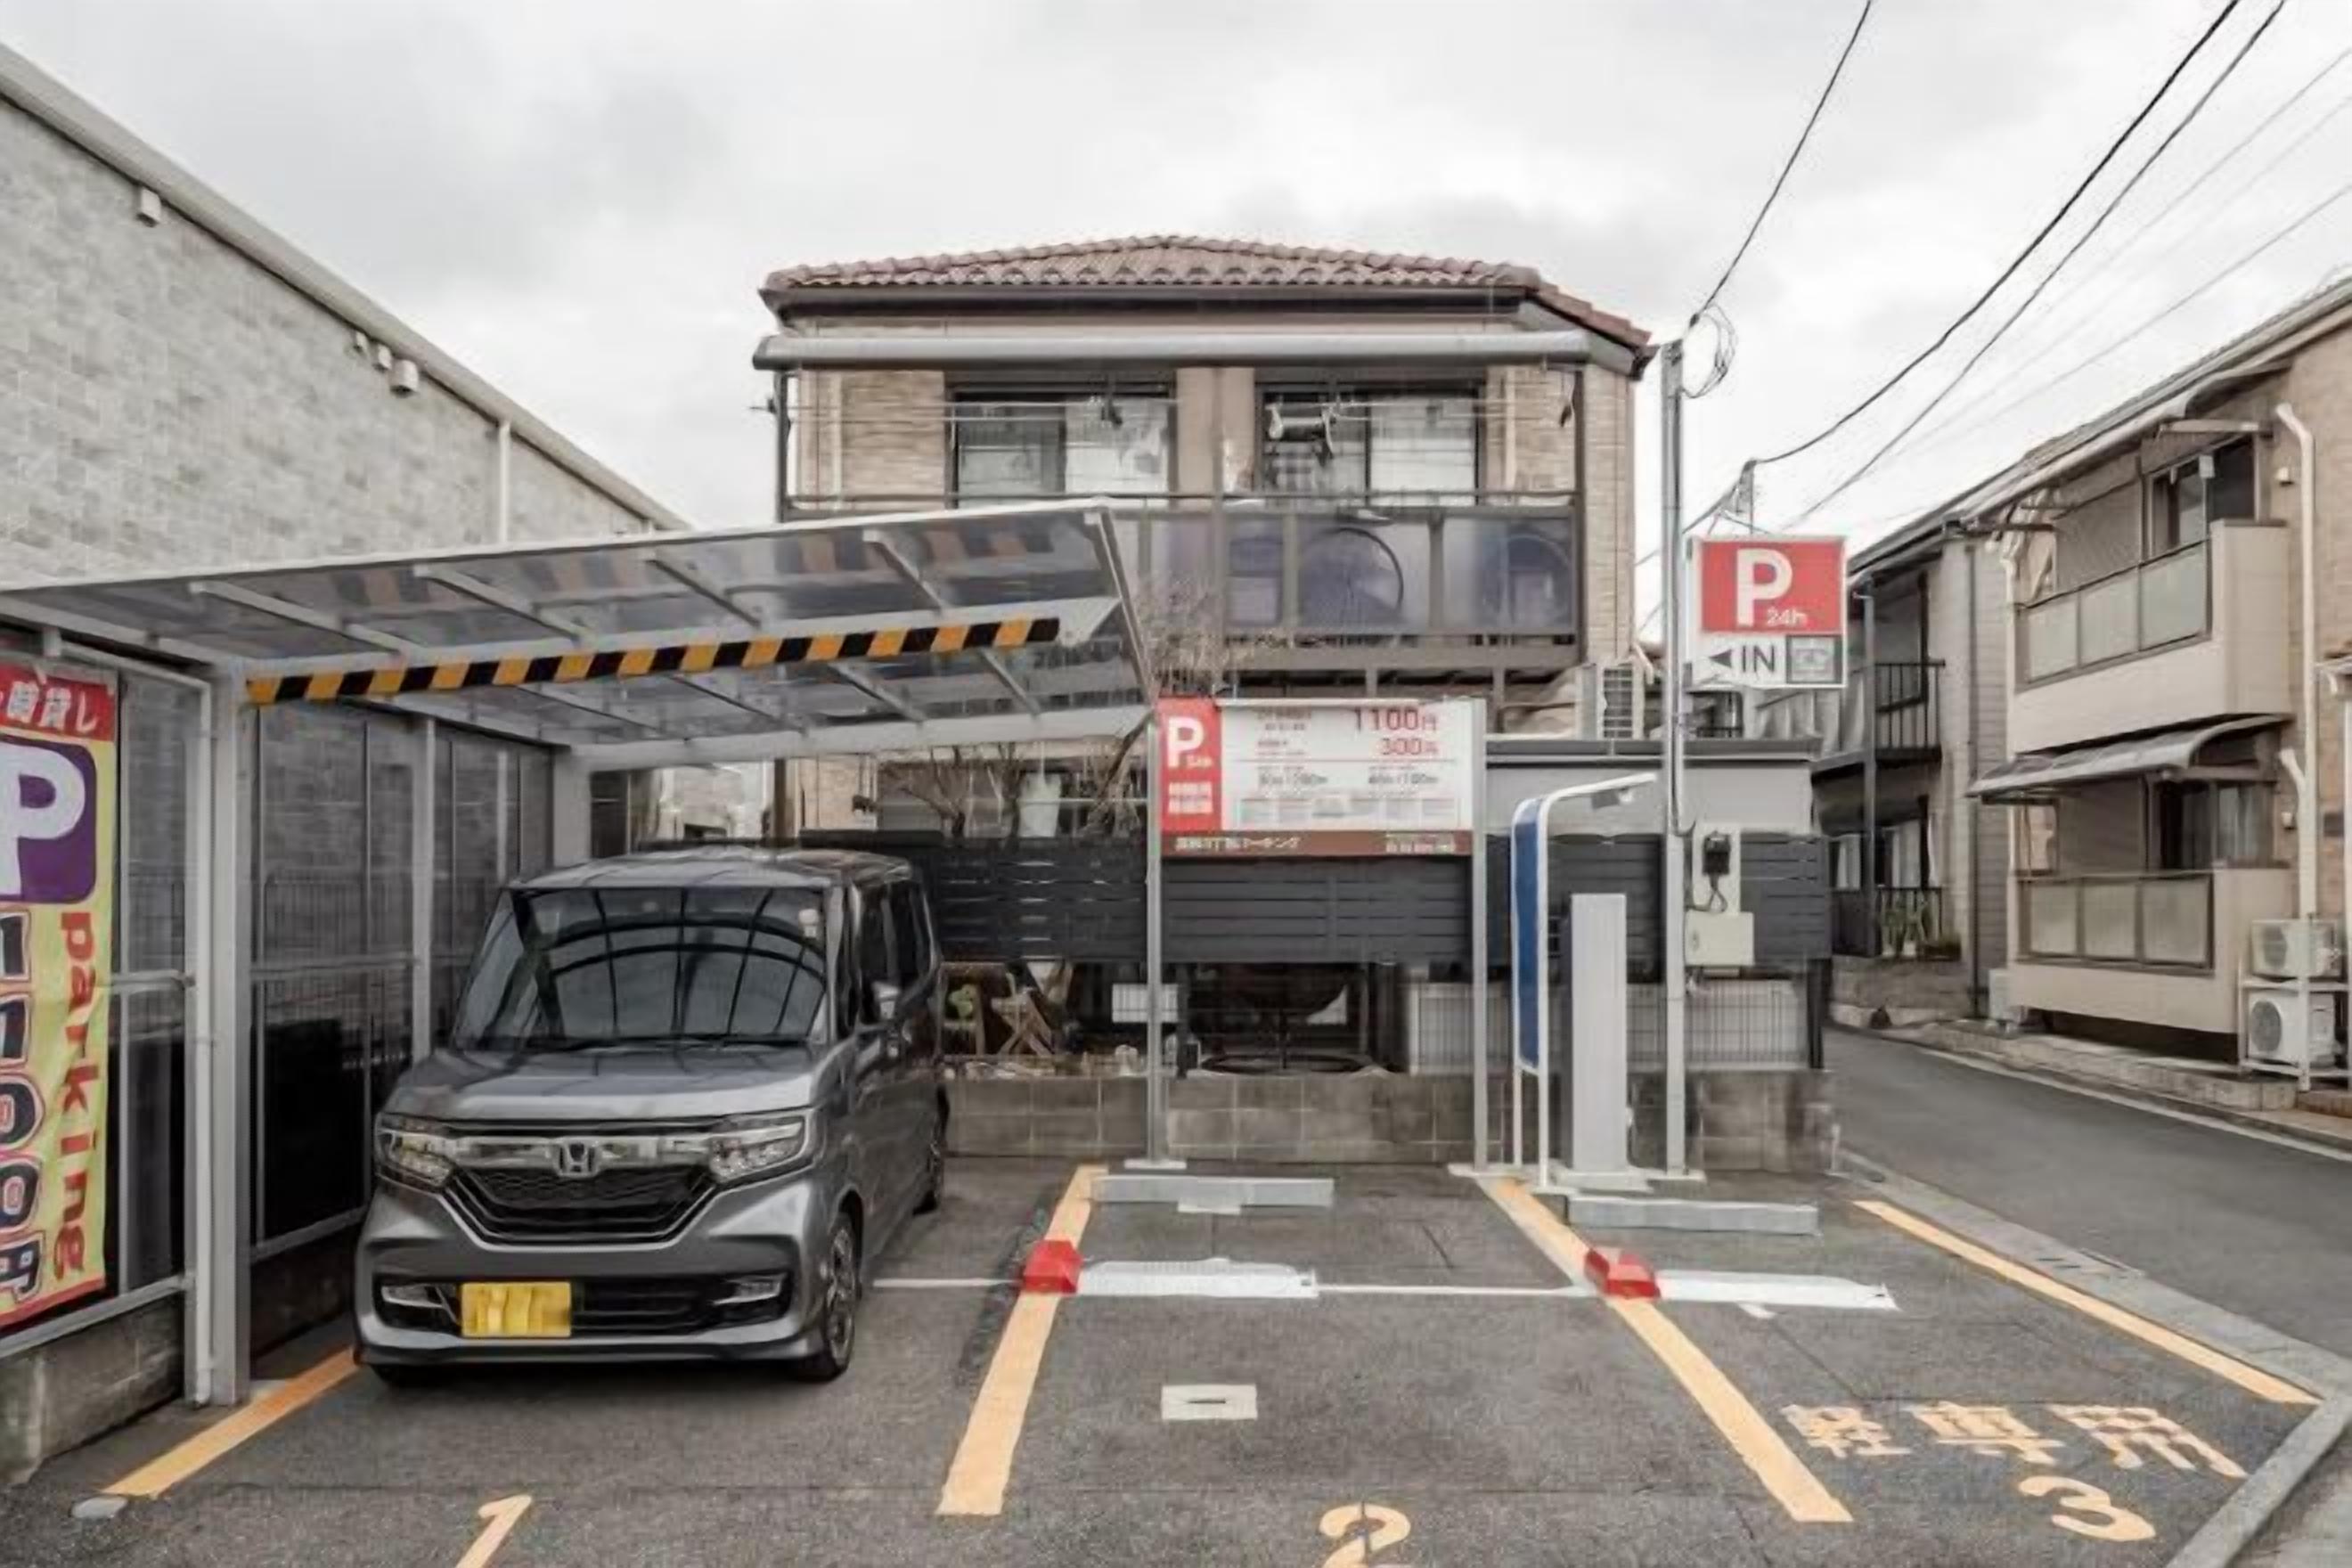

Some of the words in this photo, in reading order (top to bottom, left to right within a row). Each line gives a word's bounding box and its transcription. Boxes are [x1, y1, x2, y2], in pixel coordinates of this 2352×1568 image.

[1736, 548, 1793, 627] P
[1767, 607, 1808, 627] 24h
[1742, 644, 1776, 674] IN
[1167, 716, 1205, 768] P
[0, 741, 86, 895] P
[53, 911, 98, 1281] parking
[454, 1493, 532, 1568] 1
[1318, 1502, 1412, 1568] 2
[2018, 1474, 2157, 1542] 3
